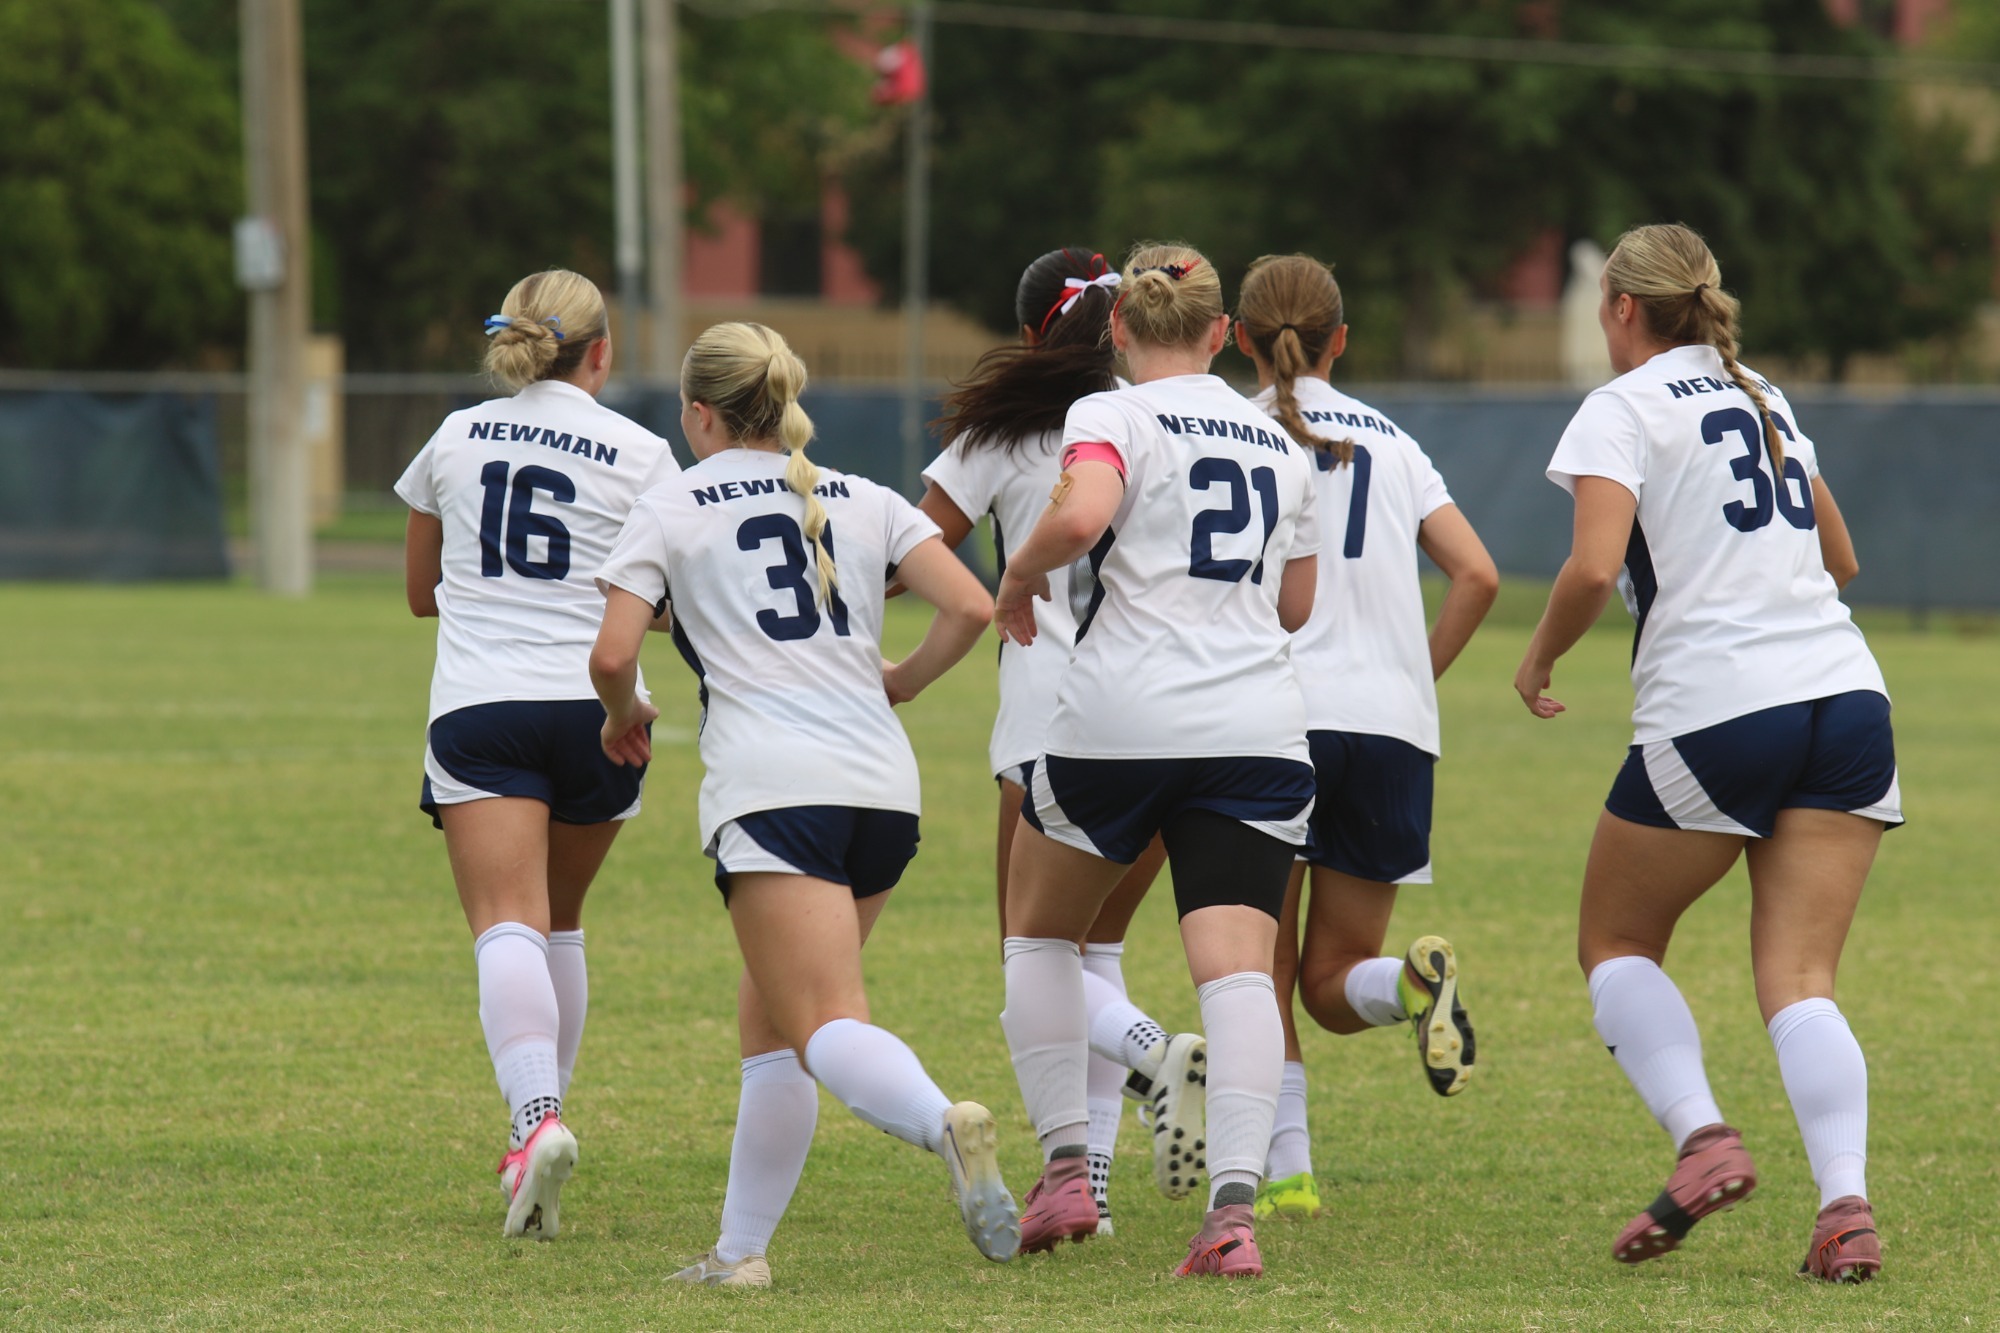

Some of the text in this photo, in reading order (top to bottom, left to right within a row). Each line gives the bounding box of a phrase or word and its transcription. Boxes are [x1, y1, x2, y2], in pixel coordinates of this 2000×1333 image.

[468, 422, 619, 466] NEWMAN
[1157, 414, 1290, 456] NEWMAN
[1300, 410, 1397, 438] WMAN
[1701, 407, 1816, 533] 36
[480, 460, 576, 581] 16
[1188, 457, 1279, 586] 21
[1314, 440, 1372, 559] 7
[736, 512, 852, 642] 31
